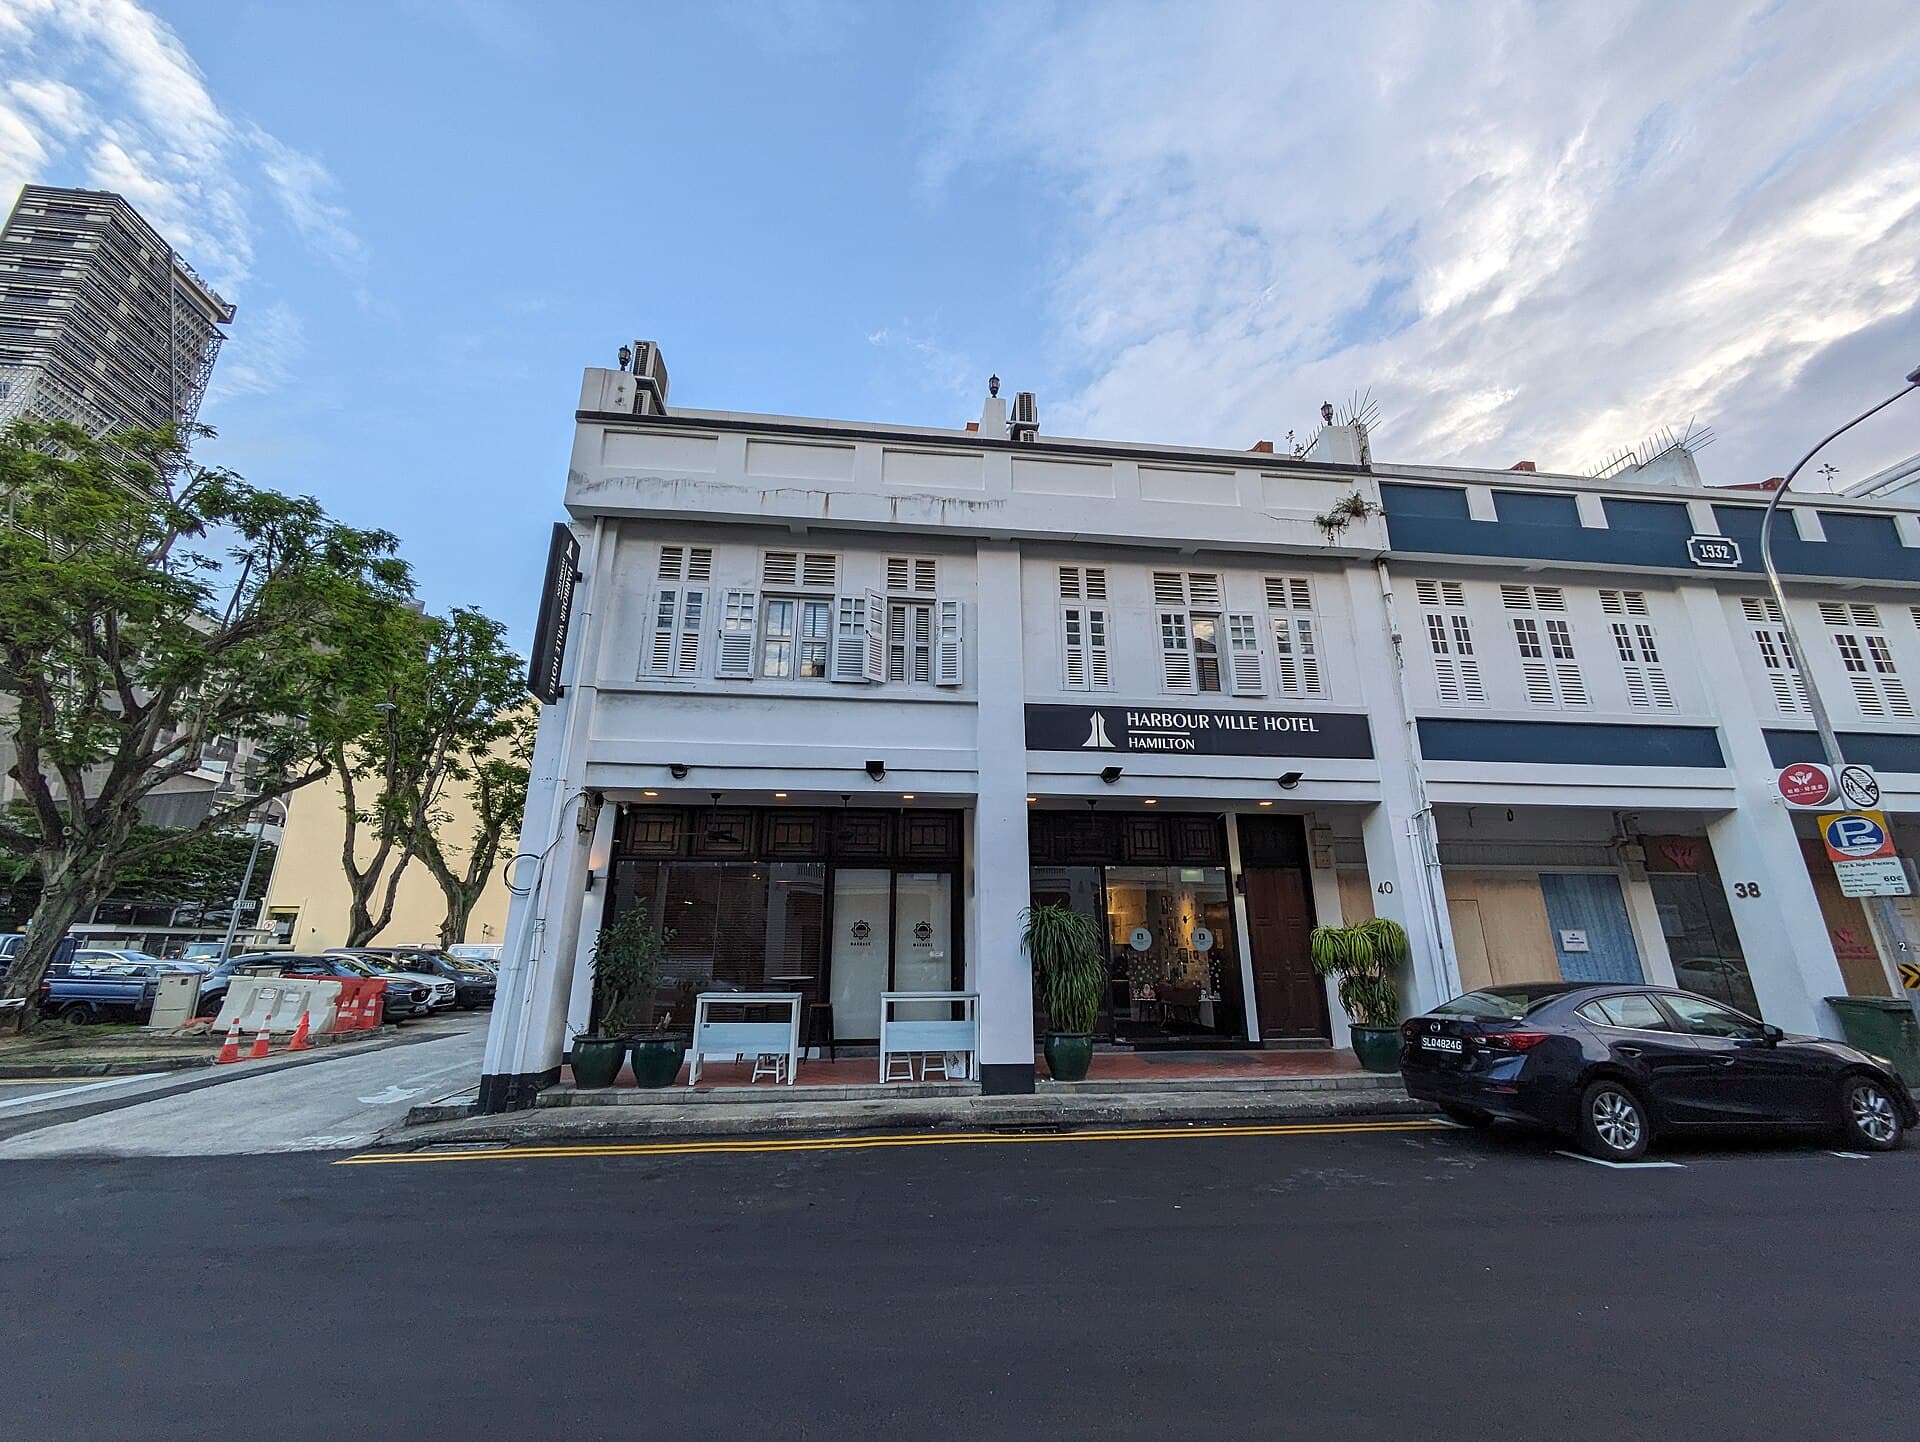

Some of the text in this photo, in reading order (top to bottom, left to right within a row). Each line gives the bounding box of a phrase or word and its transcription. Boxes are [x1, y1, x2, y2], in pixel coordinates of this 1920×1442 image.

[1699, 544, 1731, 559] 1932
[548, 565, 574, 696] HARBOUR VILLE HOTEL
[1127, 712, 1320, 732] HARBOUR VILLE HOTEL
[1128, 737, 1195, 750] HAMILTON
[1835, 818, 1874, 847] P
[1377, 881, 1393, 895] 40
[1734, 882, 1762, 898] 38
[1898, 941, 1907, 952] 2
